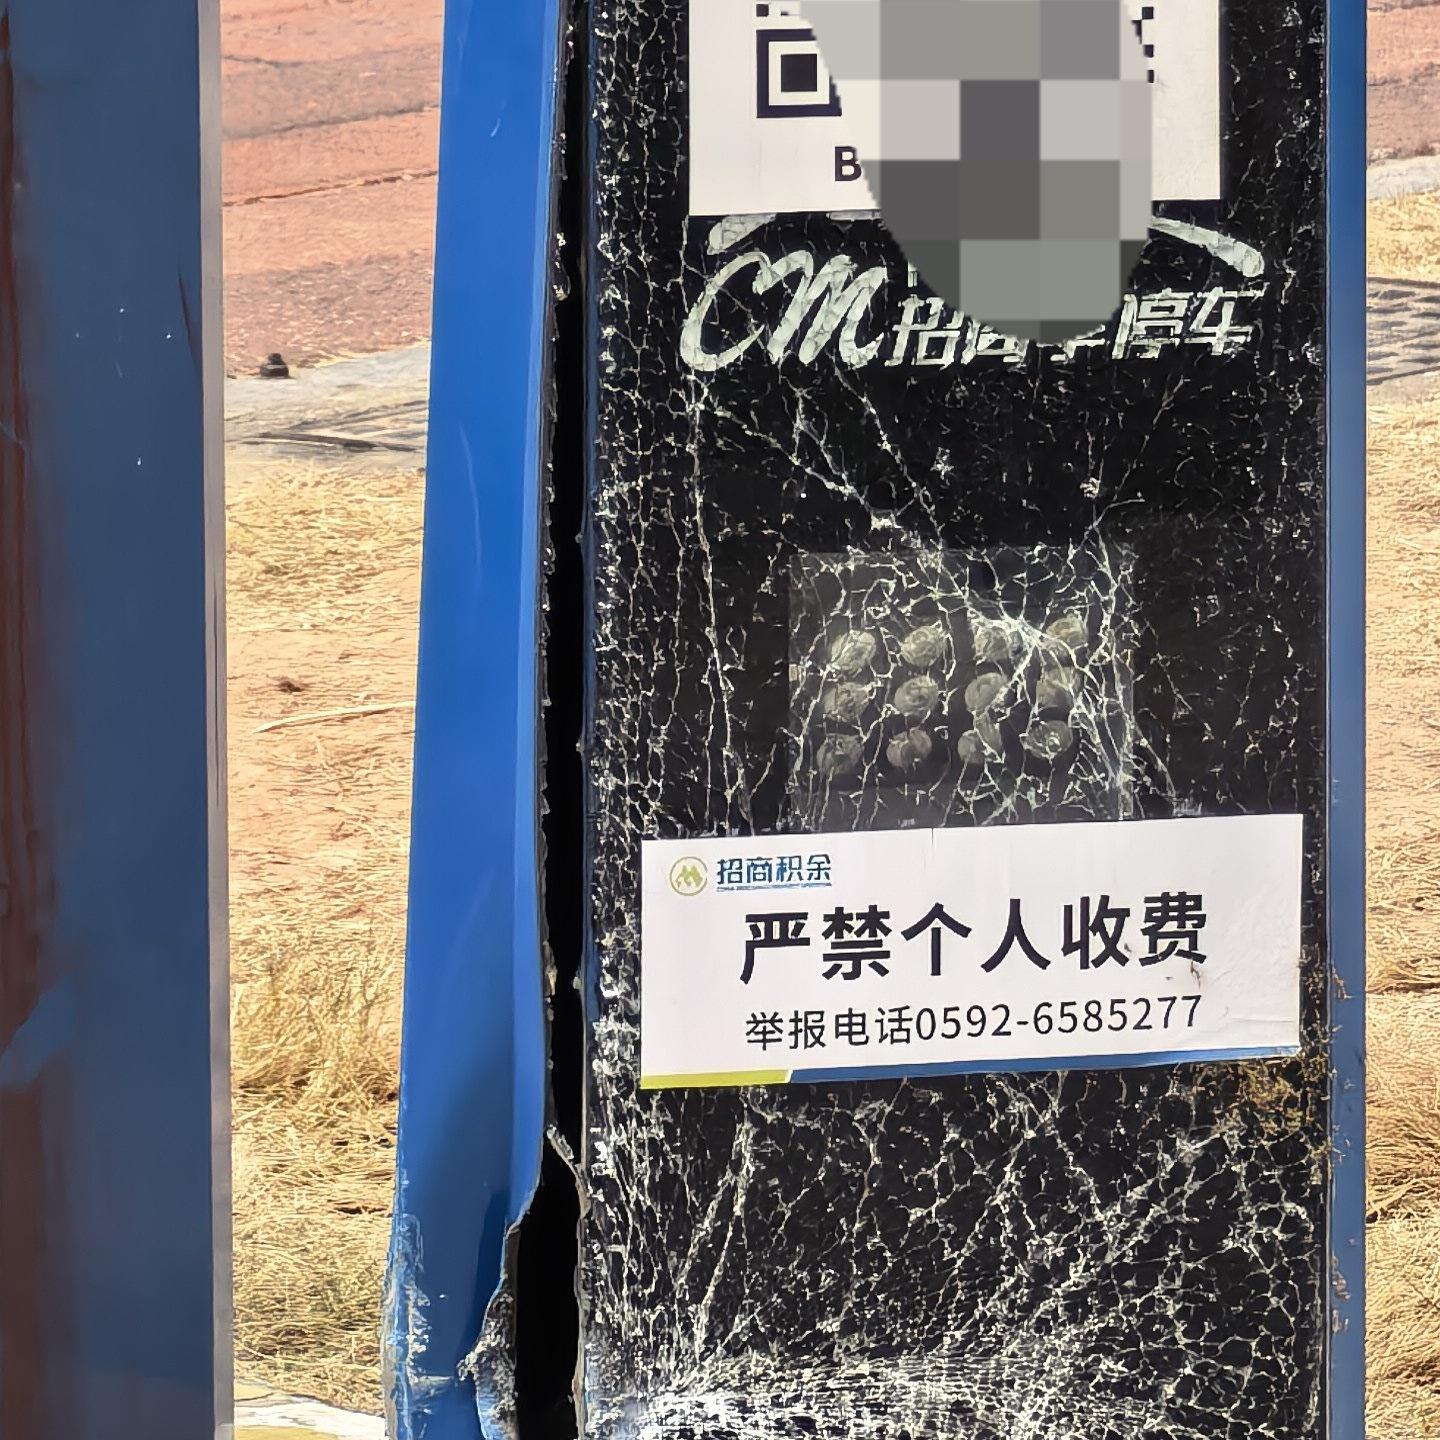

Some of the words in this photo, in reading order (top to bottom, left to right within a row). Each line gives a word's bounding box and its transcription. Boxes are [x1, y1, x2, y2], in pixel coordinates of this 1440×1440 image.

[716, 854, 832, 885] 招商积余
[740, 891, 1208, 985] 严禁个人收费
[744, 994, 1203, 1051] 举报电话0592-6585277
